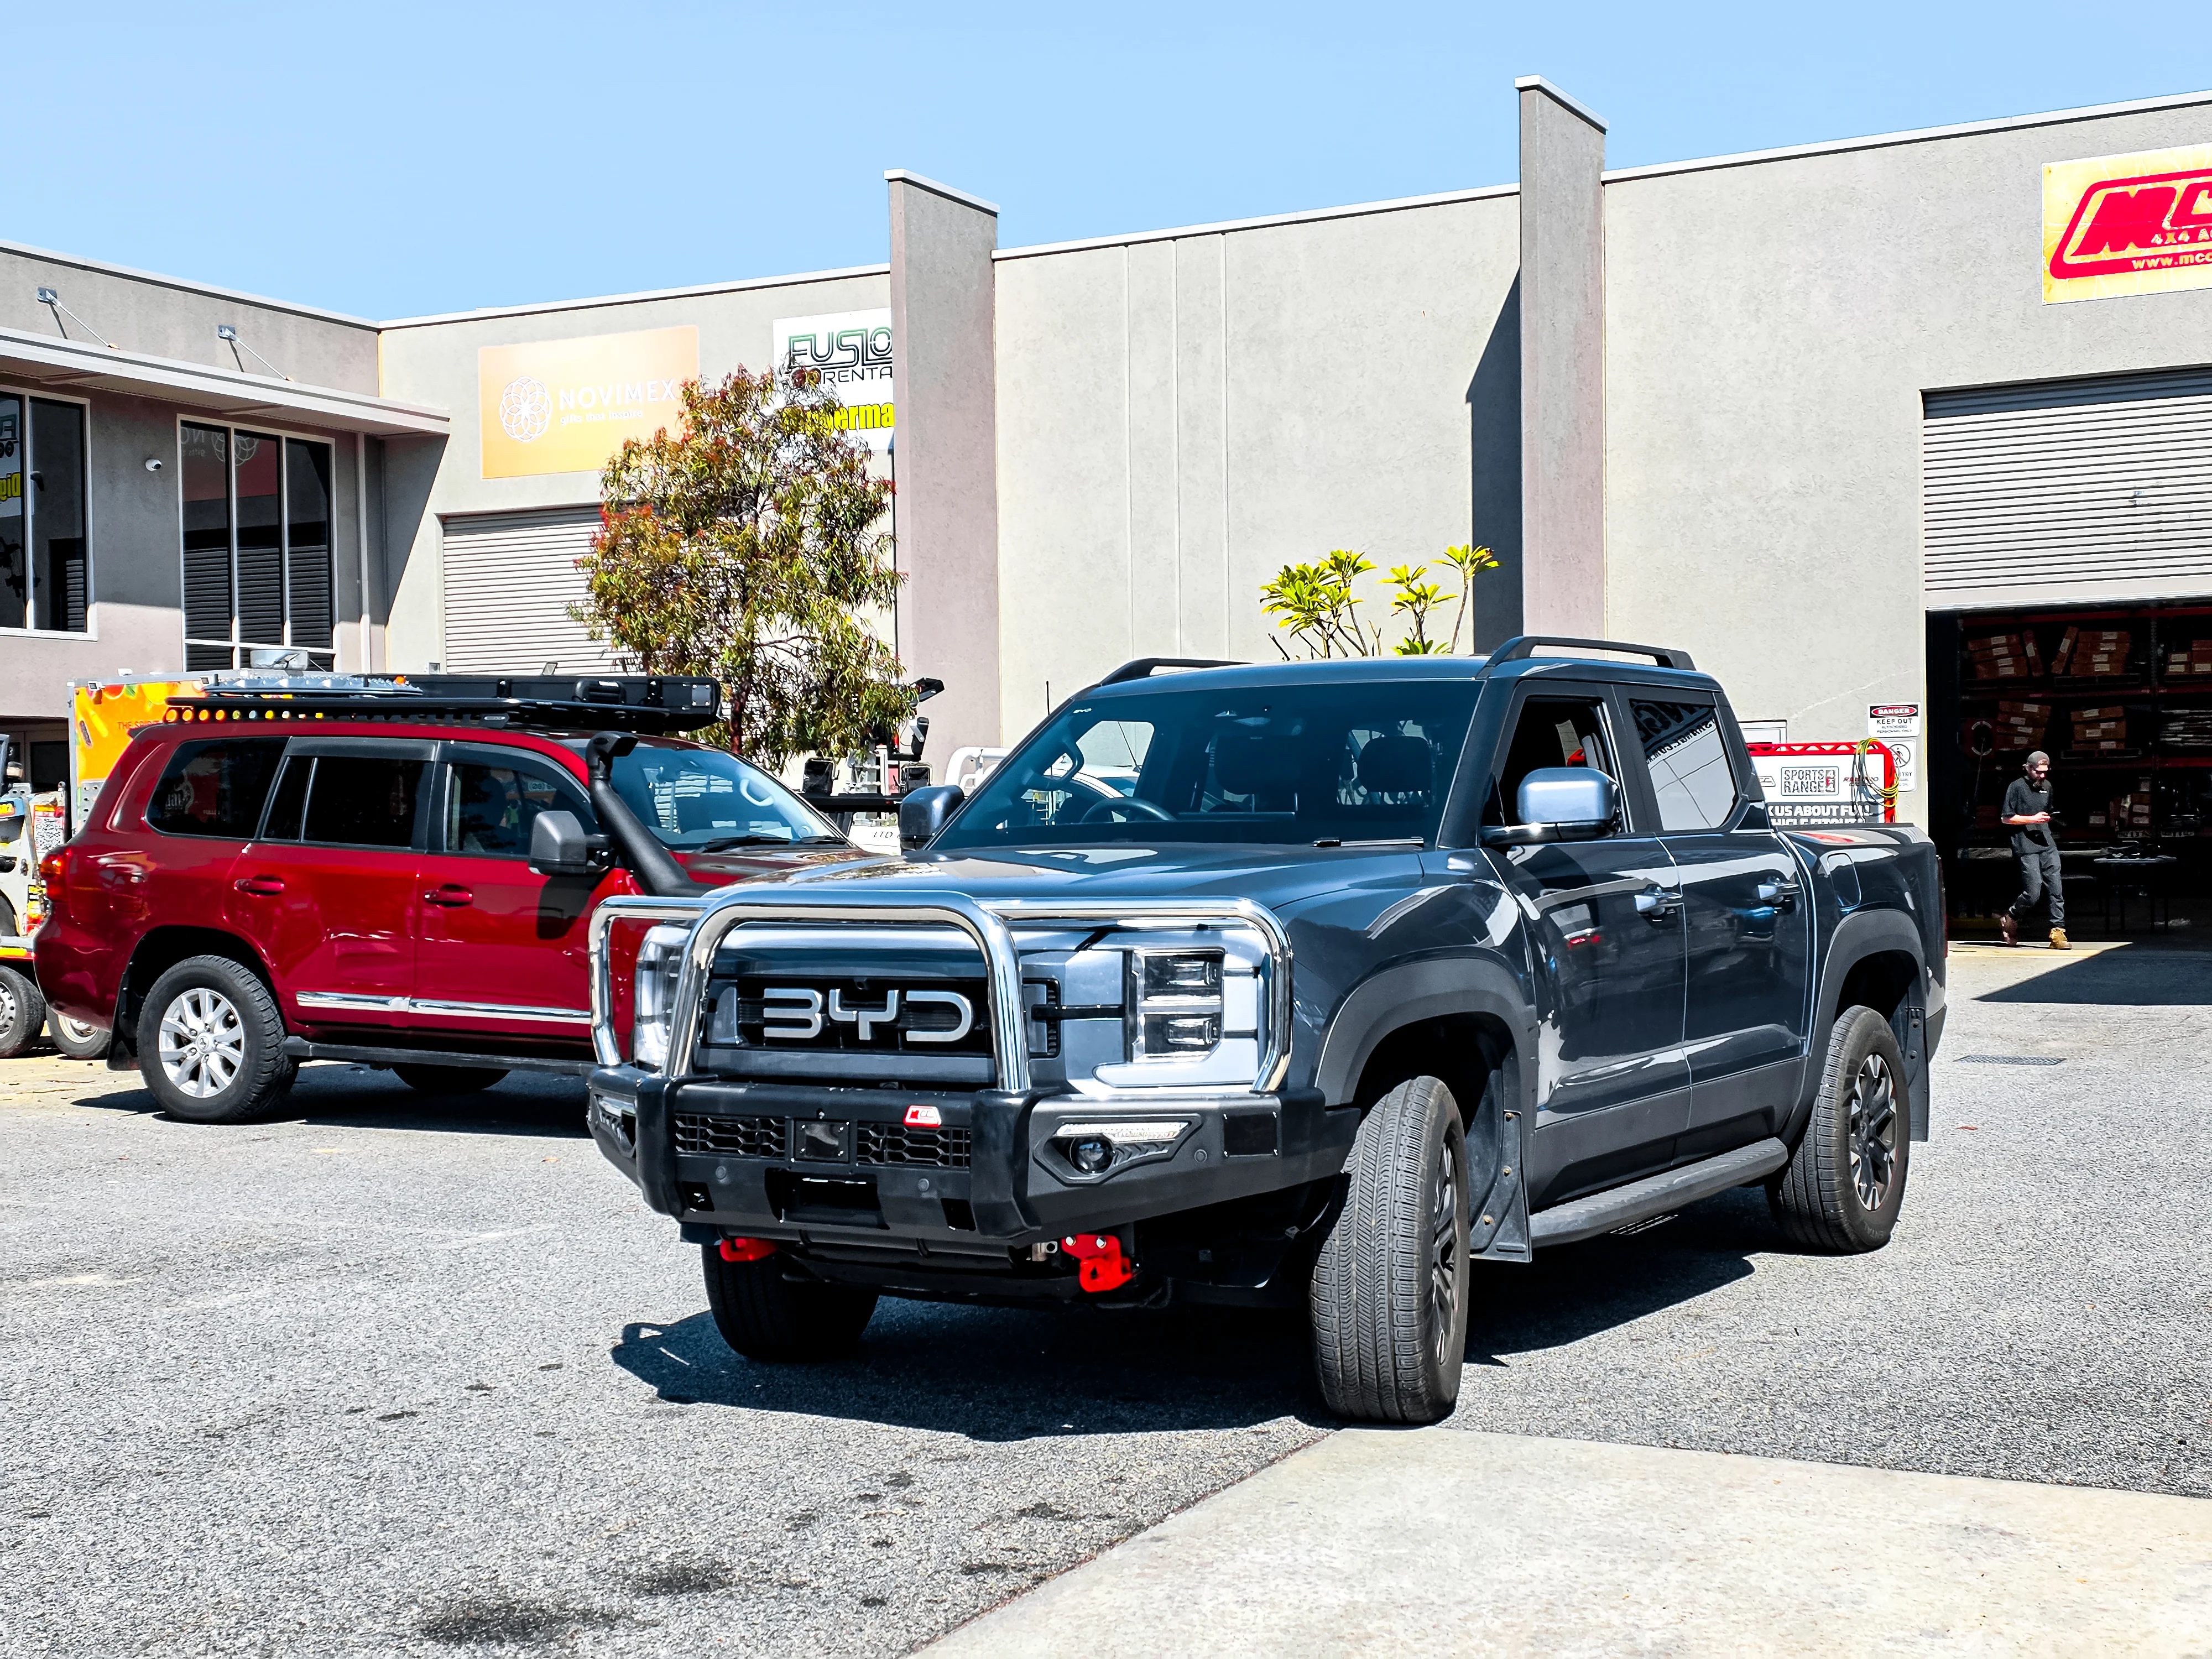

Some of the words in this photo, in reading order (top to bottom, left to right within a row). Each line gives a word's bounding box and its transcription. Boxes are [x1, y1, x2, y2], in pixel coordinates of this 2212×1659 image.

[2151, 230, 2190, 245] 4X4
[559, 378, 676, 411] NOVIMEX
[560, 415, 582, 426] gifts
[585, 413, 605, 422] that
[608, 409, 643, 421] inspire
[1784, 769, 1824, 781] SPORTS
[1783, 780, 1824, 793] RANGE
[1775, 806, 1792, 817] US
[1793, 805, 1839, 817] ABOUT
[764, 988, 974, 1042] BYD
